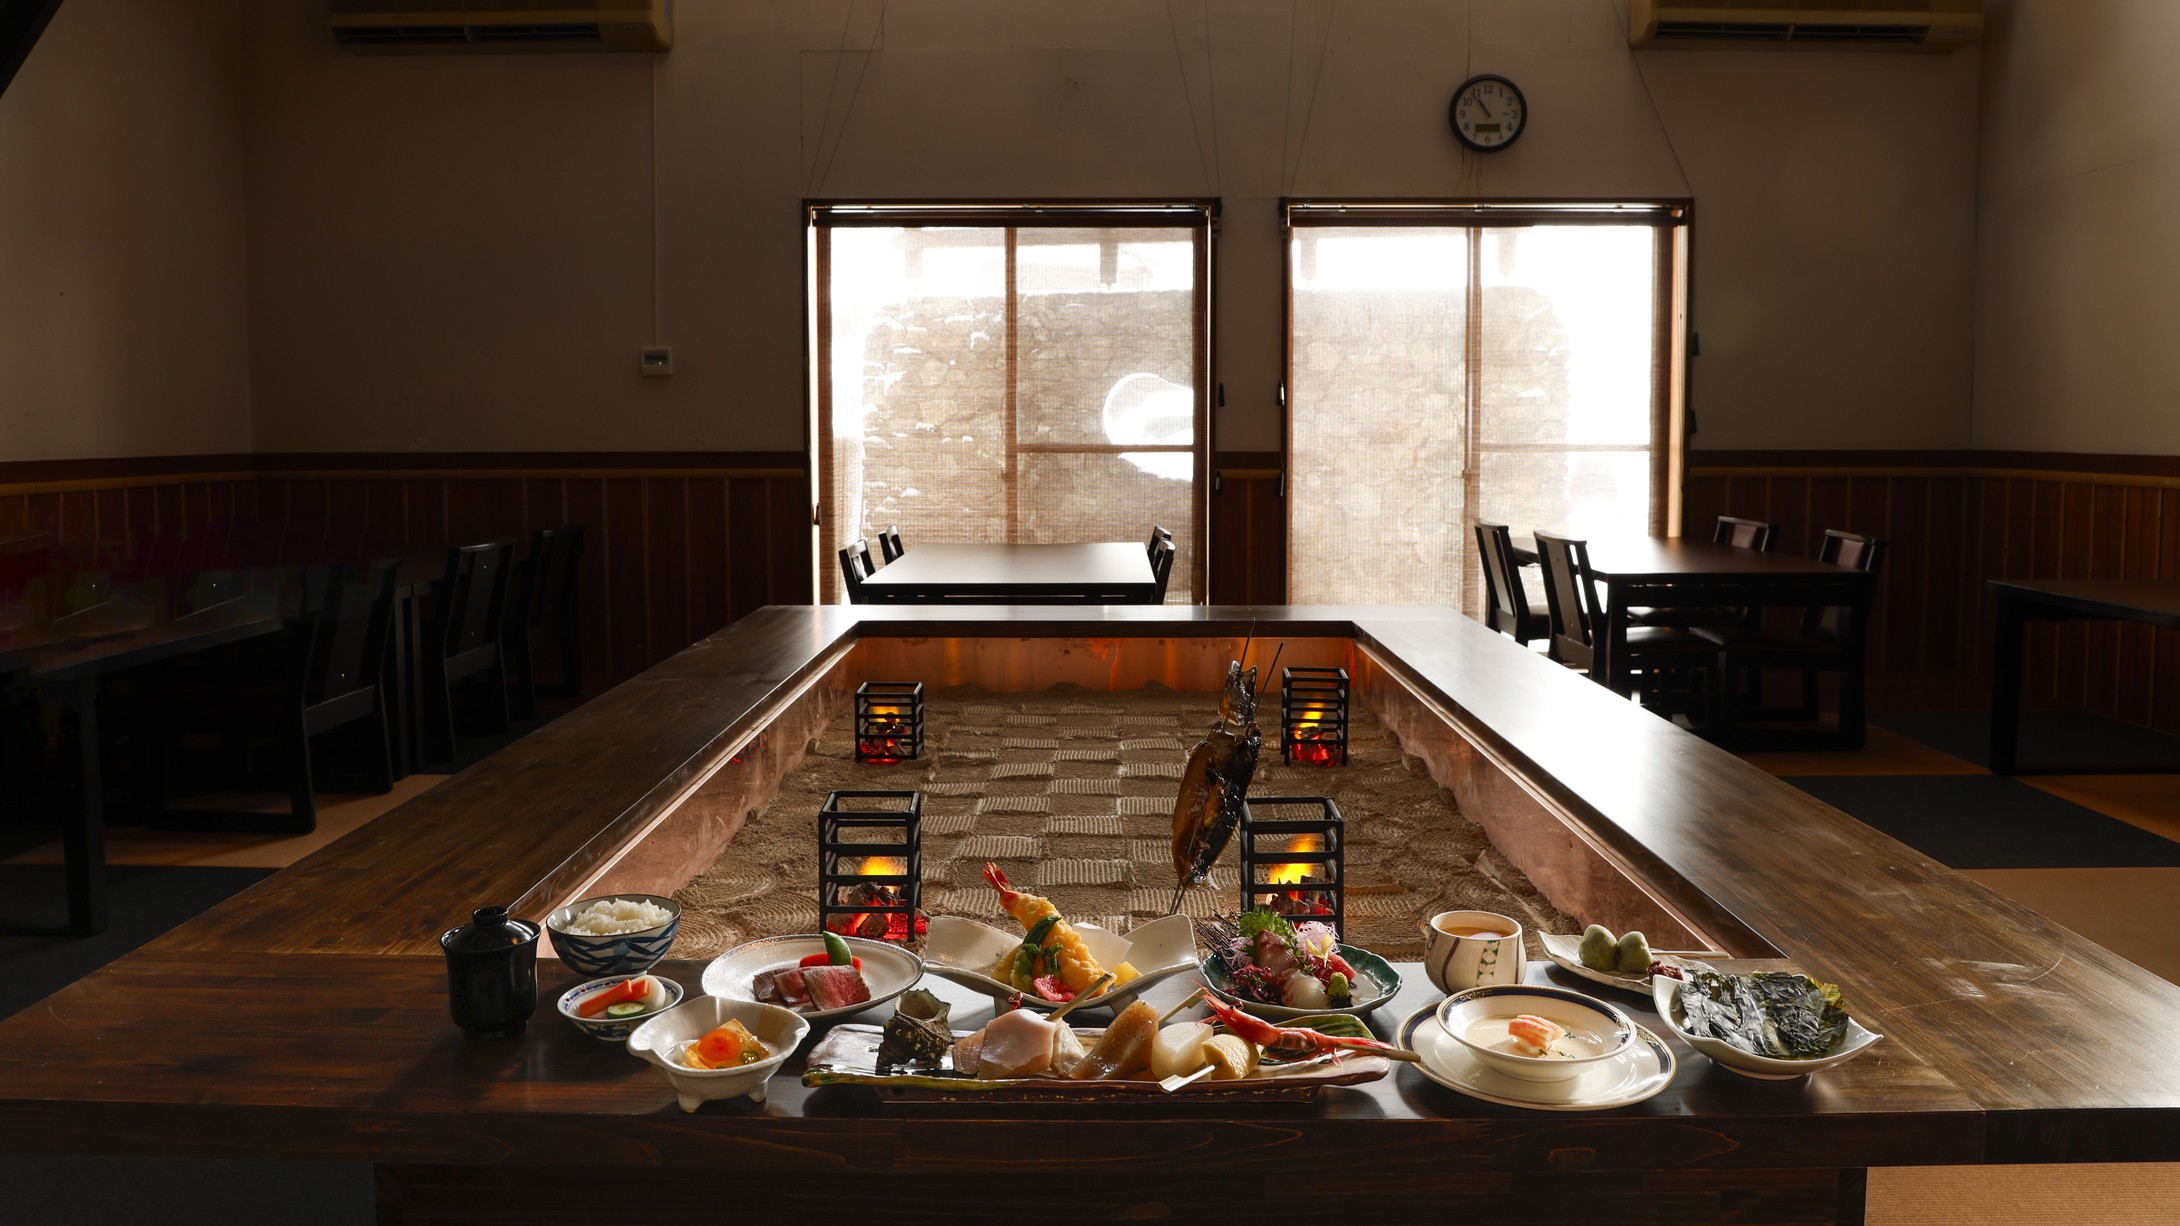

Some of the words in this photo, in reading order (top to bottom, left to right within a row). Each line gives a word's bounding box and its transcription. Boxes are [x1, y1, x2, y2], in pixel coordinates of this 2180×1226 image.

[1483, 84, 1494, 94] 12
[1499, 88, 1503, 97] 1
[1463, 97, 1473, 106] 10
[1506, 97, 1513, 106] 2
[1459, 110, 1466, 119] 9
[1511, 110, 1518, 119] 3
[1464, 122, 1470, 131] 8
[1506, 122, 1513, 132] 4
[1484, 134, 1491, 143] 6
